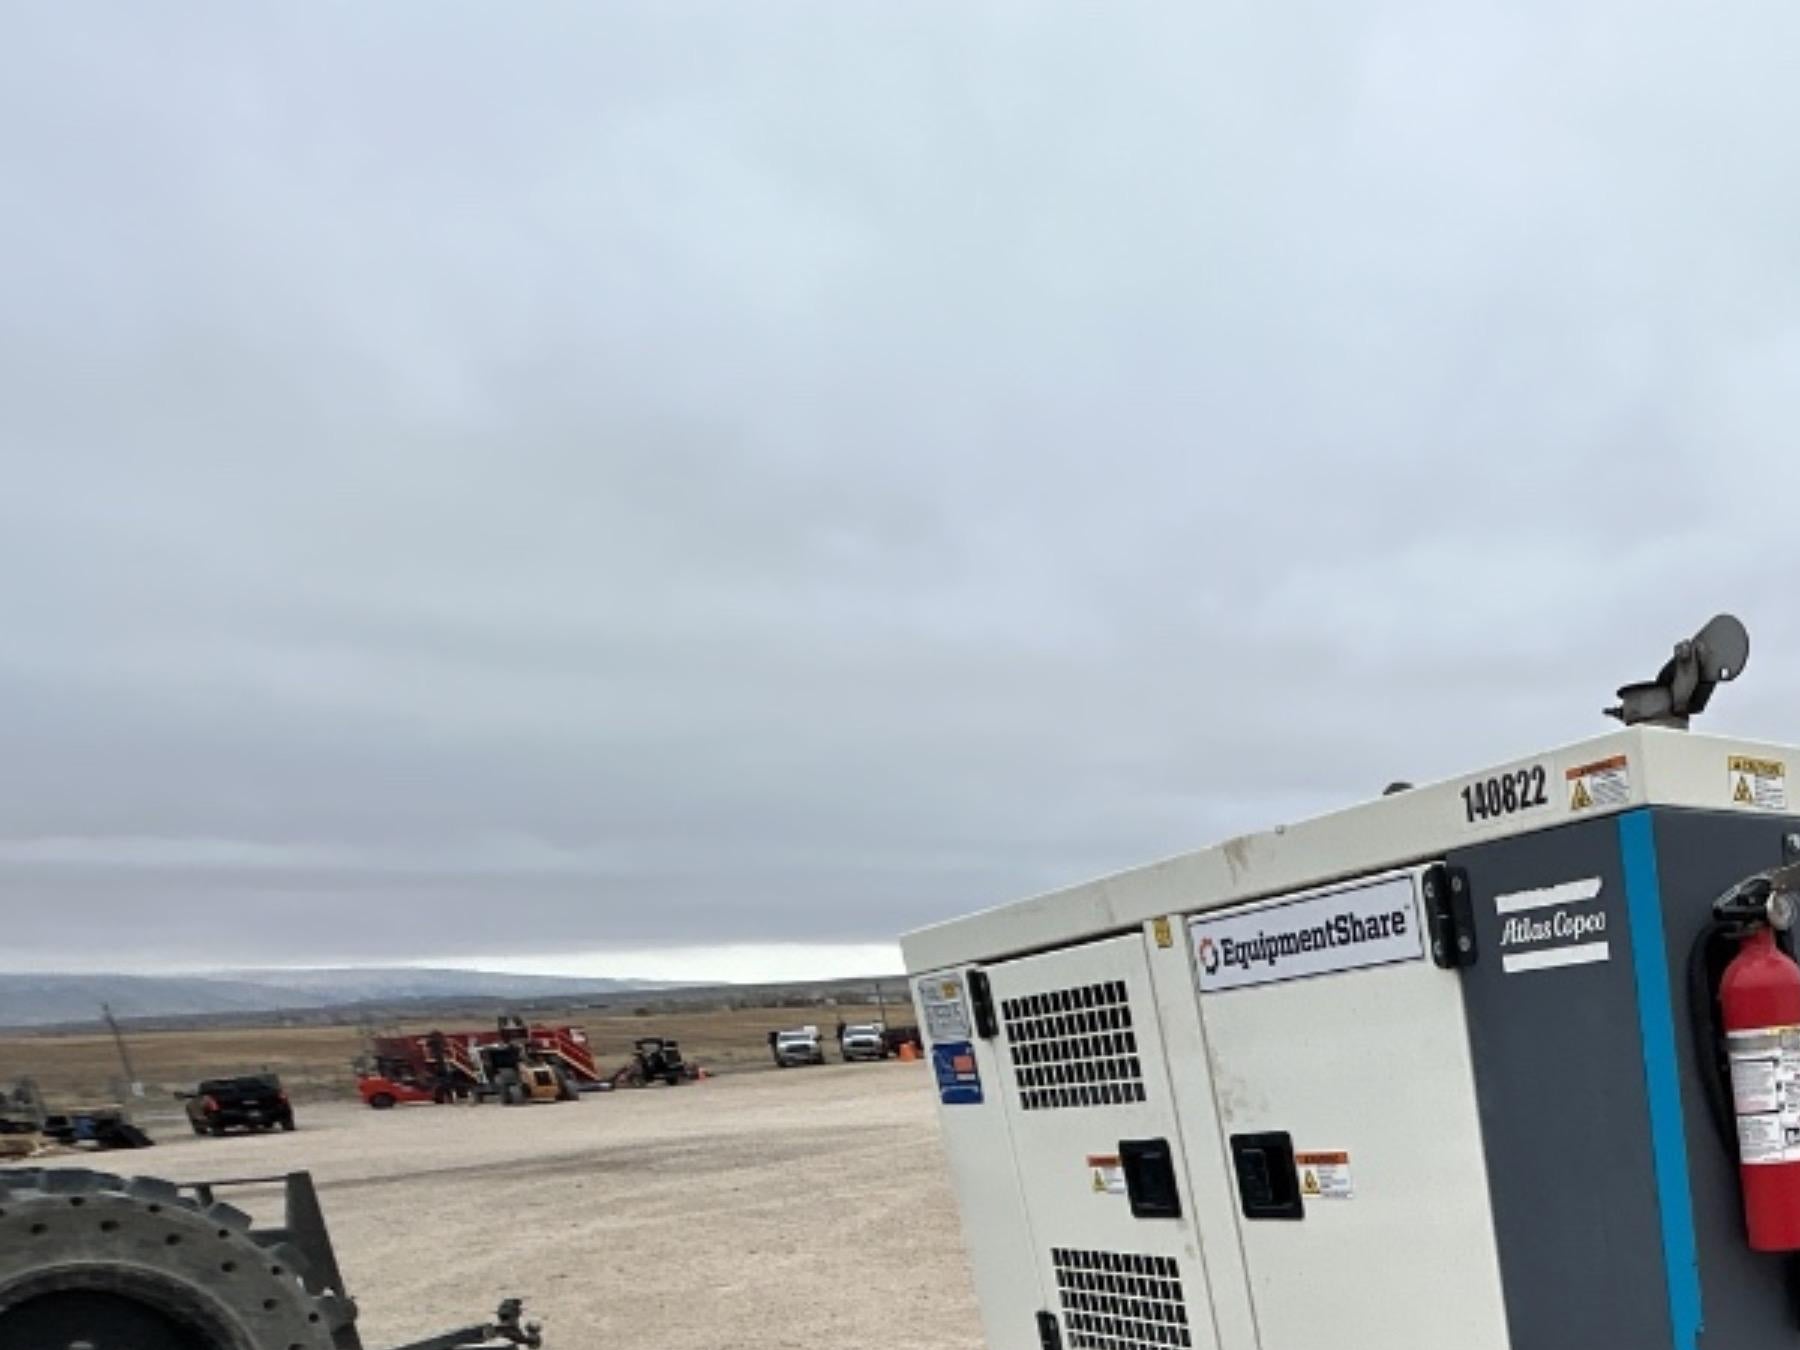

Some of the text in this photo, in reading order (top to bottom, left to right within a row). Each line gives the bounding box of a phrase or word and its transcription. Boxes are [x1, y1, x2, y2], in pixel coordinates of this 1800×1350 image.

[1461, 764, 1548, 823] 140822
[1220, 908, 1408, 969] EquipmentShare
[1500, 910, 1606, 946] Atlas Copco
